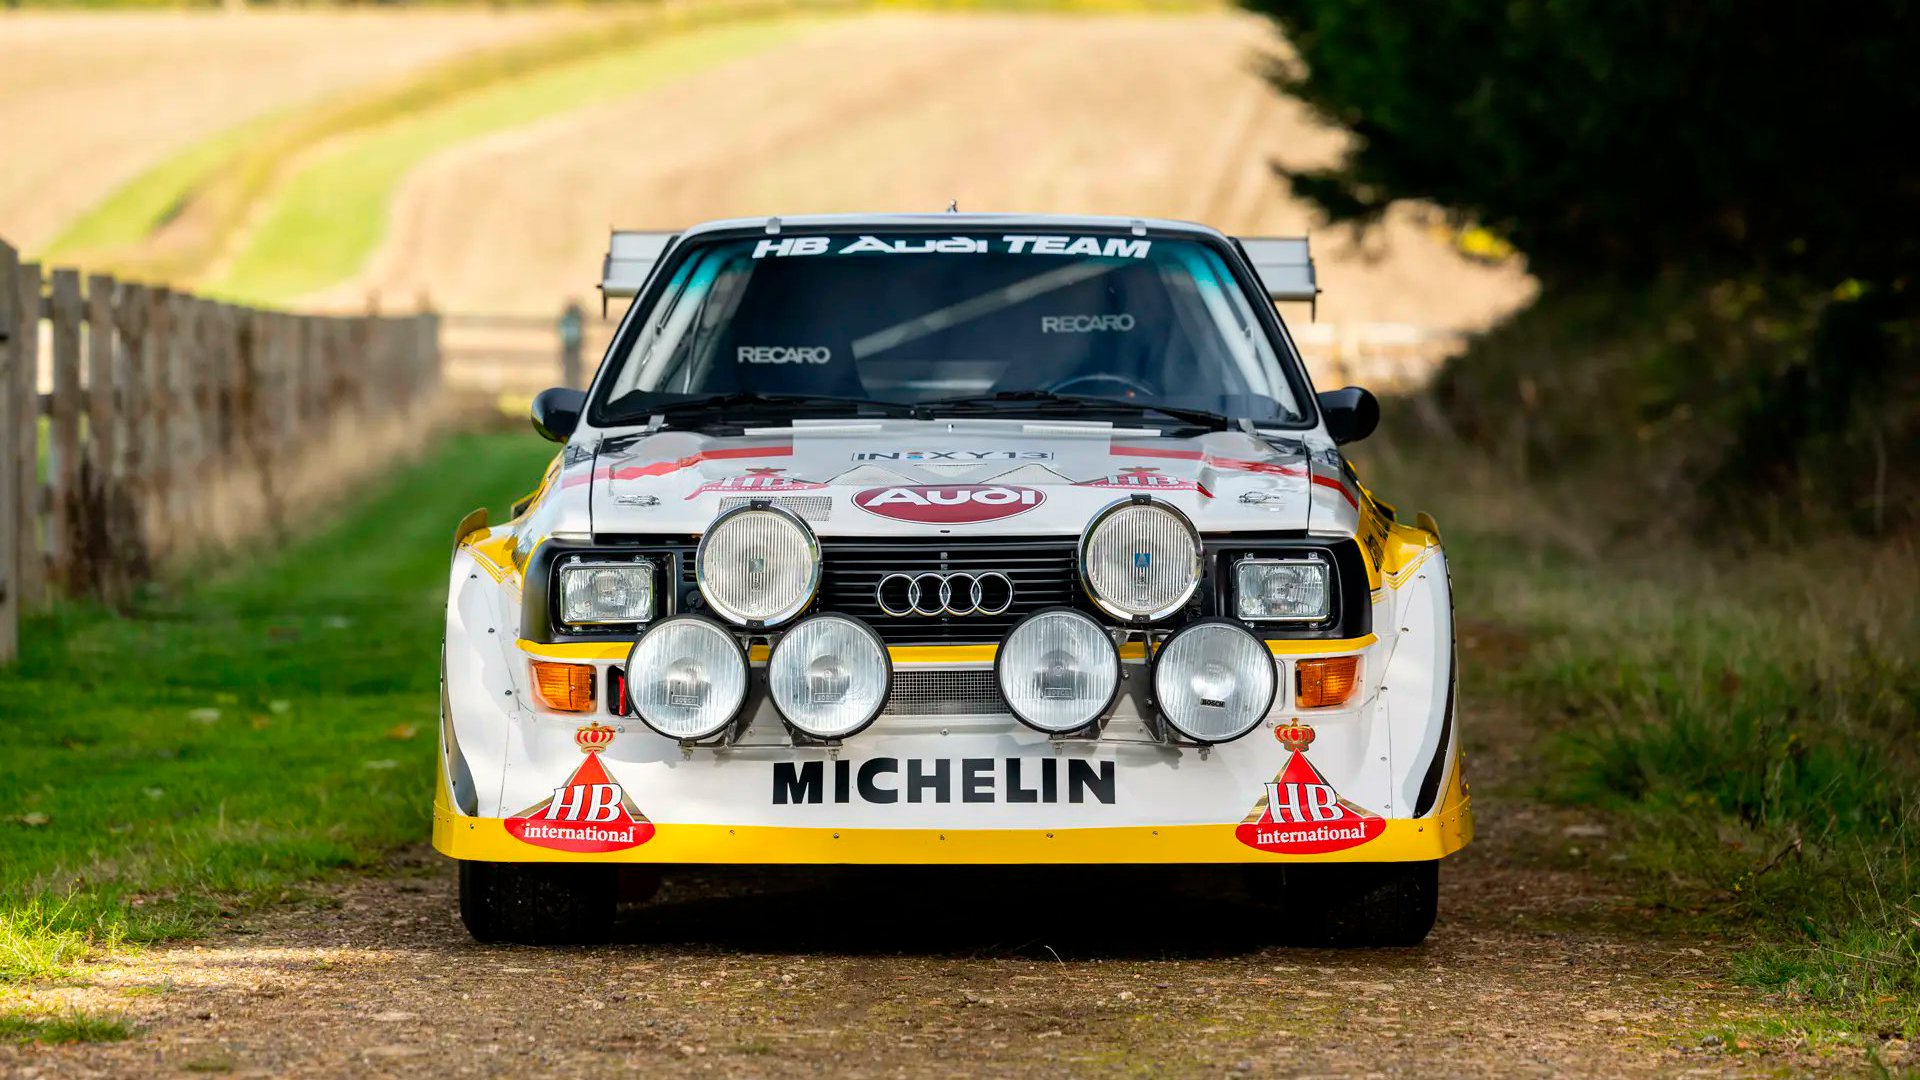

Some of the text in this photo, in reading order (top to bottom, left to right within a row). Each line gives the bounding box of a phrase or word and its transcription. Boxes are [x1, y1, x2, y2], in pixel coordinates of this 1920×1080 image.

[752, 236, 830, 258] HB
[1003, 235, 1152, 259] TEAM
[1042, 314, 1135, 333] RECARO
[737, 346, 831, 364] RECARO
[1201, 699, 1226, 708] BOSCH
[772, 757, 1116, 805] MICHELIN
[543, 782, 623, 823] HB
[1264, 782, 1345, 824] HB
[523, 823, 634, 843] international
[1256, 821, 1367, 845] international
